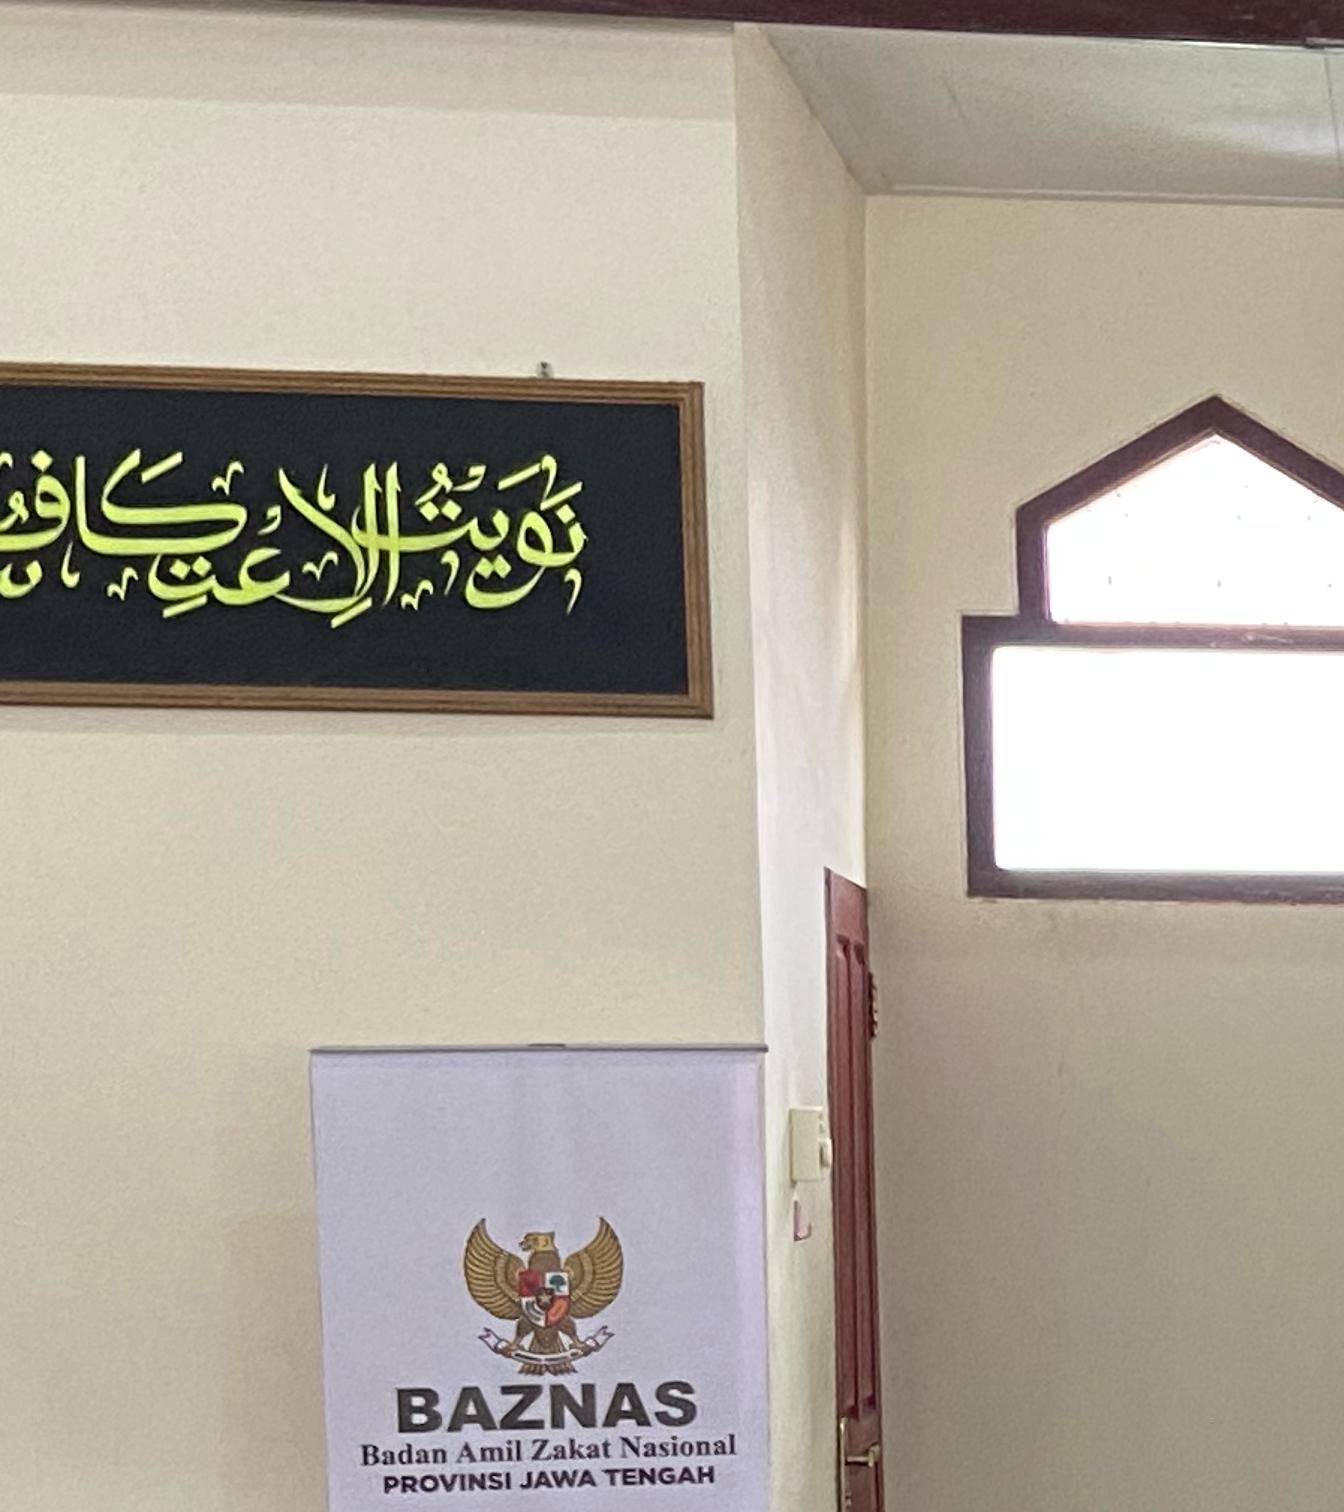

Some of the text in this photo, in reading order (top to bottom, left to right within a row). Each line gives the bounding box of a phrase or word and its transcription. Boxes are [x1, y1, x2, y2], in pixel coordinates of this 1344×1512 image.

[396, 1380, 698, 1433] BAZNAS
[360, 1433, 738, 1466] Badan Amil Zakat Nasional
[384, 1465, 716, 1495] PROVINSI JAWA TENGAH
